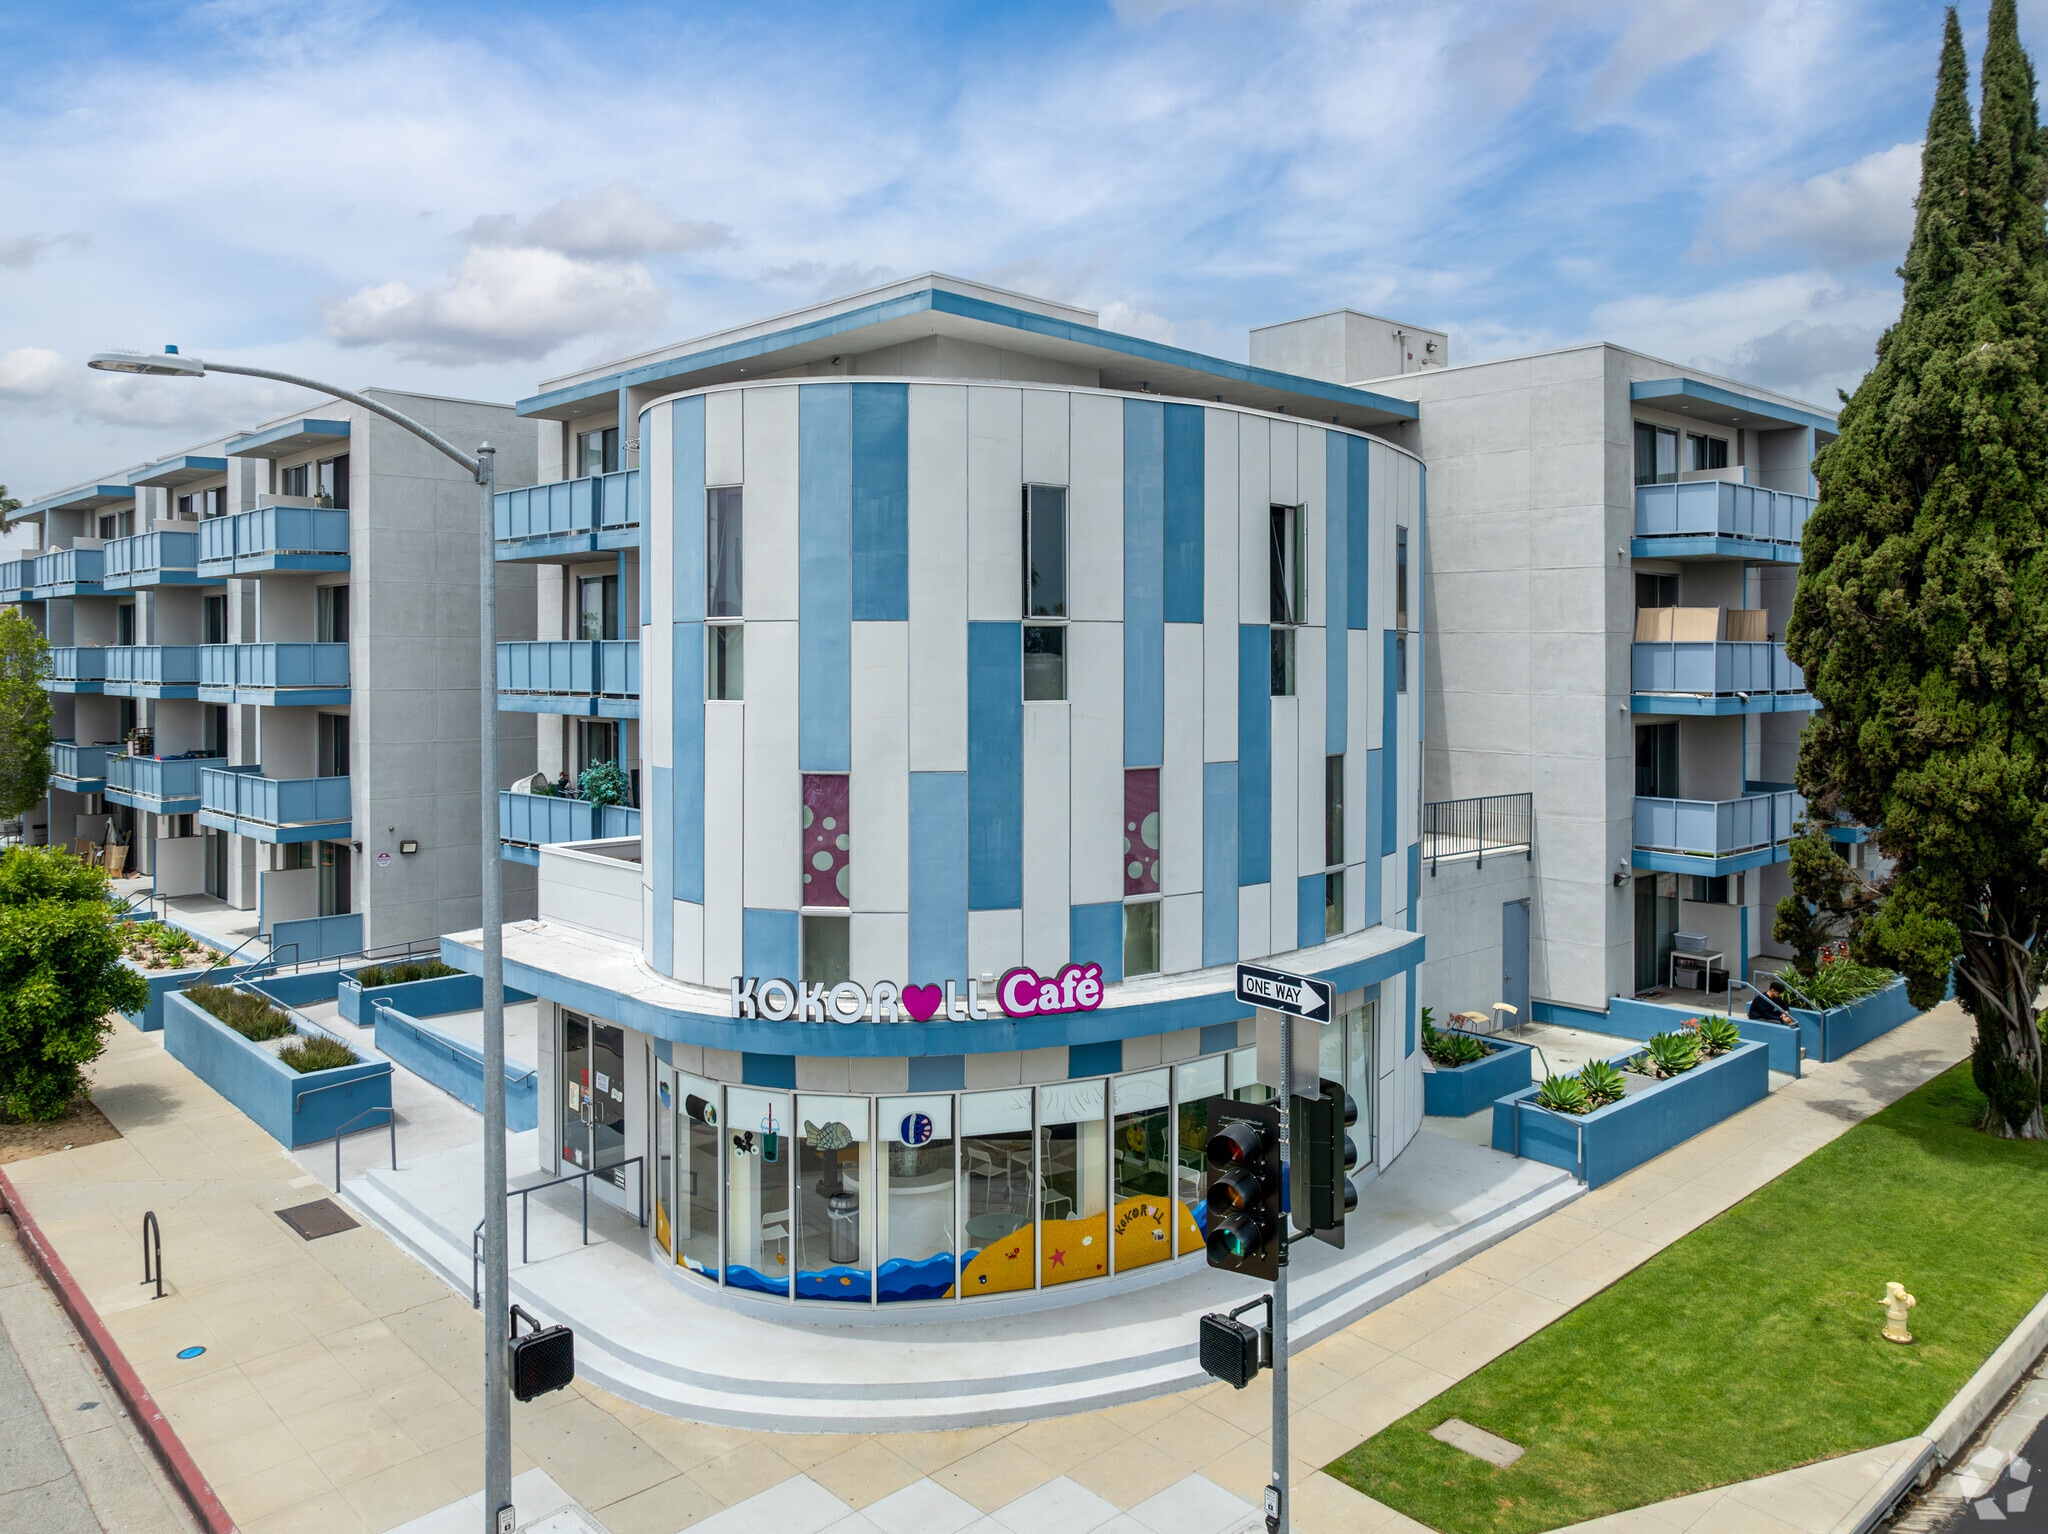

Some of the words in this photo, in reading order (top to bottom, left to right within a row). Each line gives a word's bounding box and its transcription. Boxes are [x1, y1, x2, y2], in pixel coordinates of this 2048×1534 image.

[1001, 966, 1101, 1014] Café
[1246, 977, 1271, 996] ONE
[1275, 983, 1302, 1003] WAY
